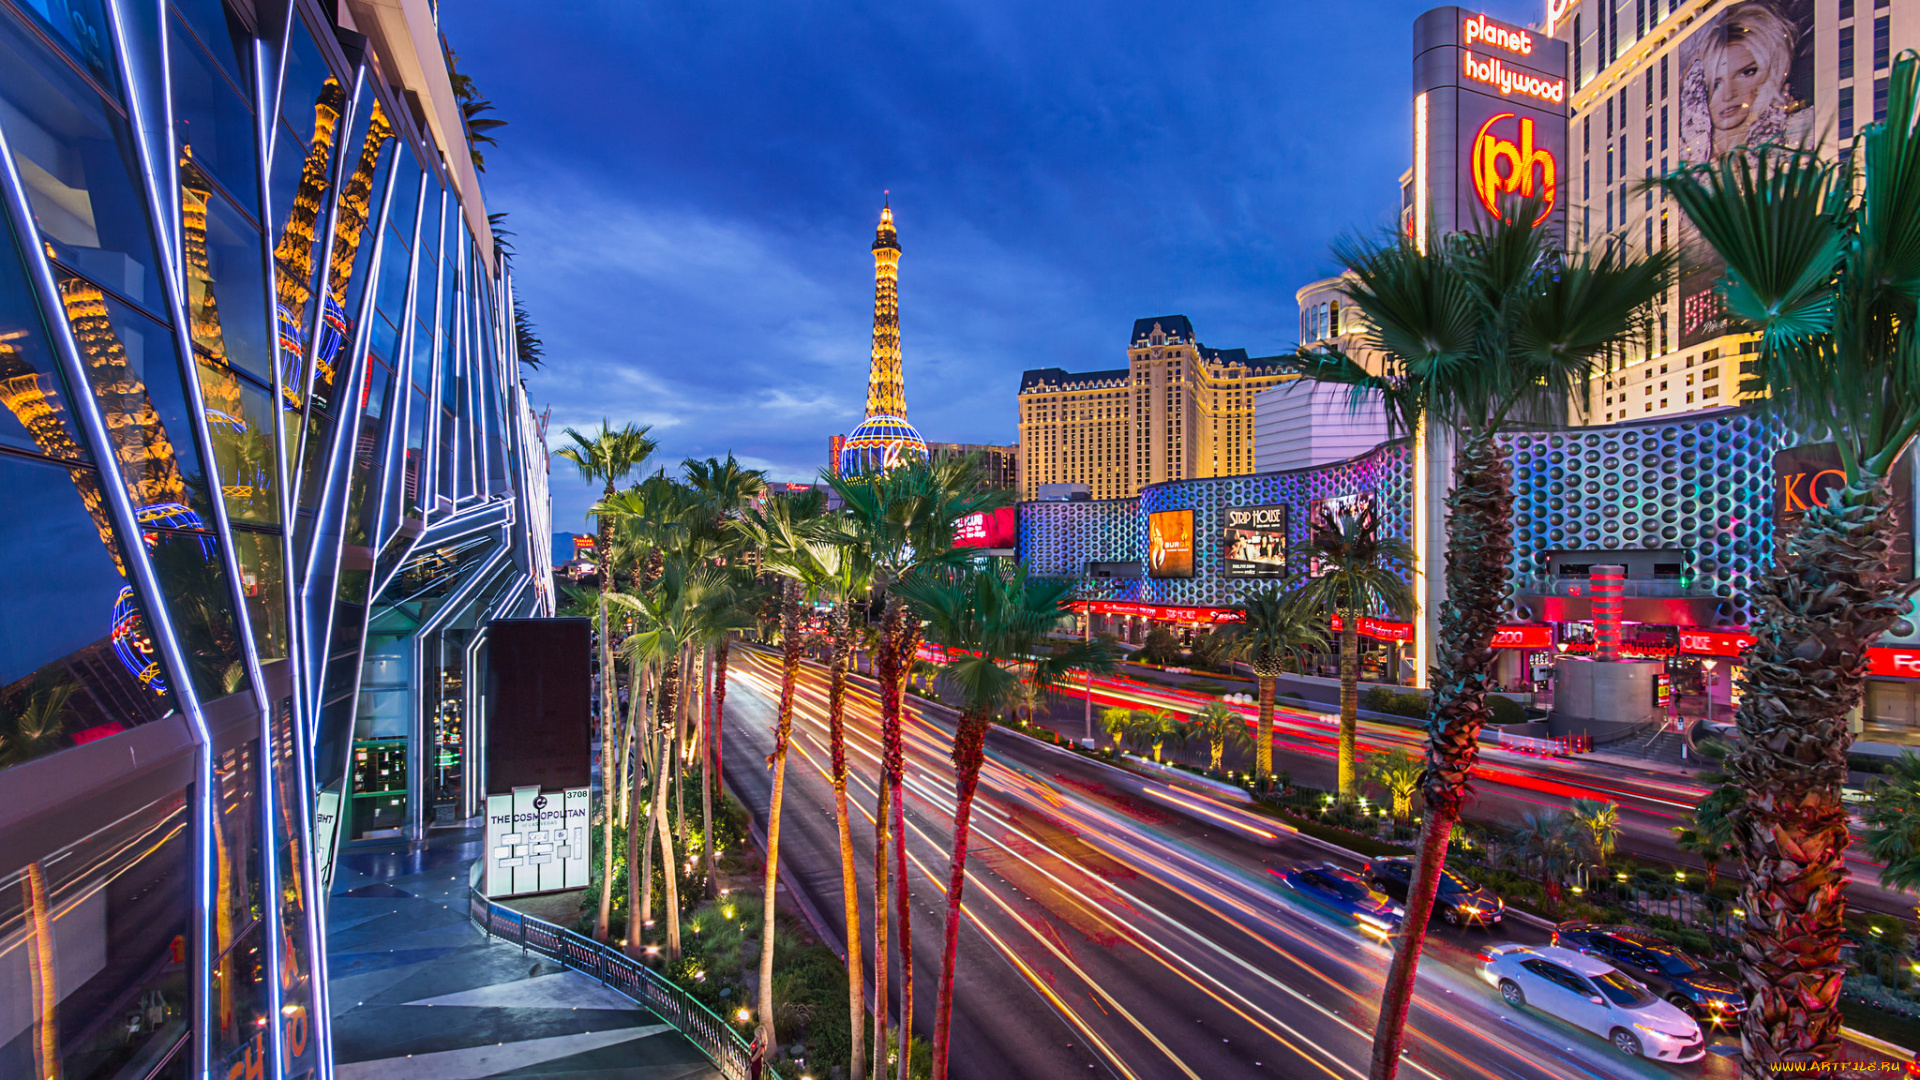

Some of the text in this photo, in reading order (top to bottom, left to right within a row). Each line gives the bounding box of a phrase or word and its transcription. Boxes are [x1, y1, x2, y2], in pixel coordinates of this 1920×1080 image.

[1464, 13, 1532, 55] planet
[1464, 49, 1564, 103] hollywood
[1480, 116, 1556, 208] ph
[1229, 509, 1281, 527] STRIP HOUSE
[1393, 627, 1409, 638] call
[566, 790, 588, 799] 3708
[491, 808, 586, 824] THE COSMOPOLITAN
